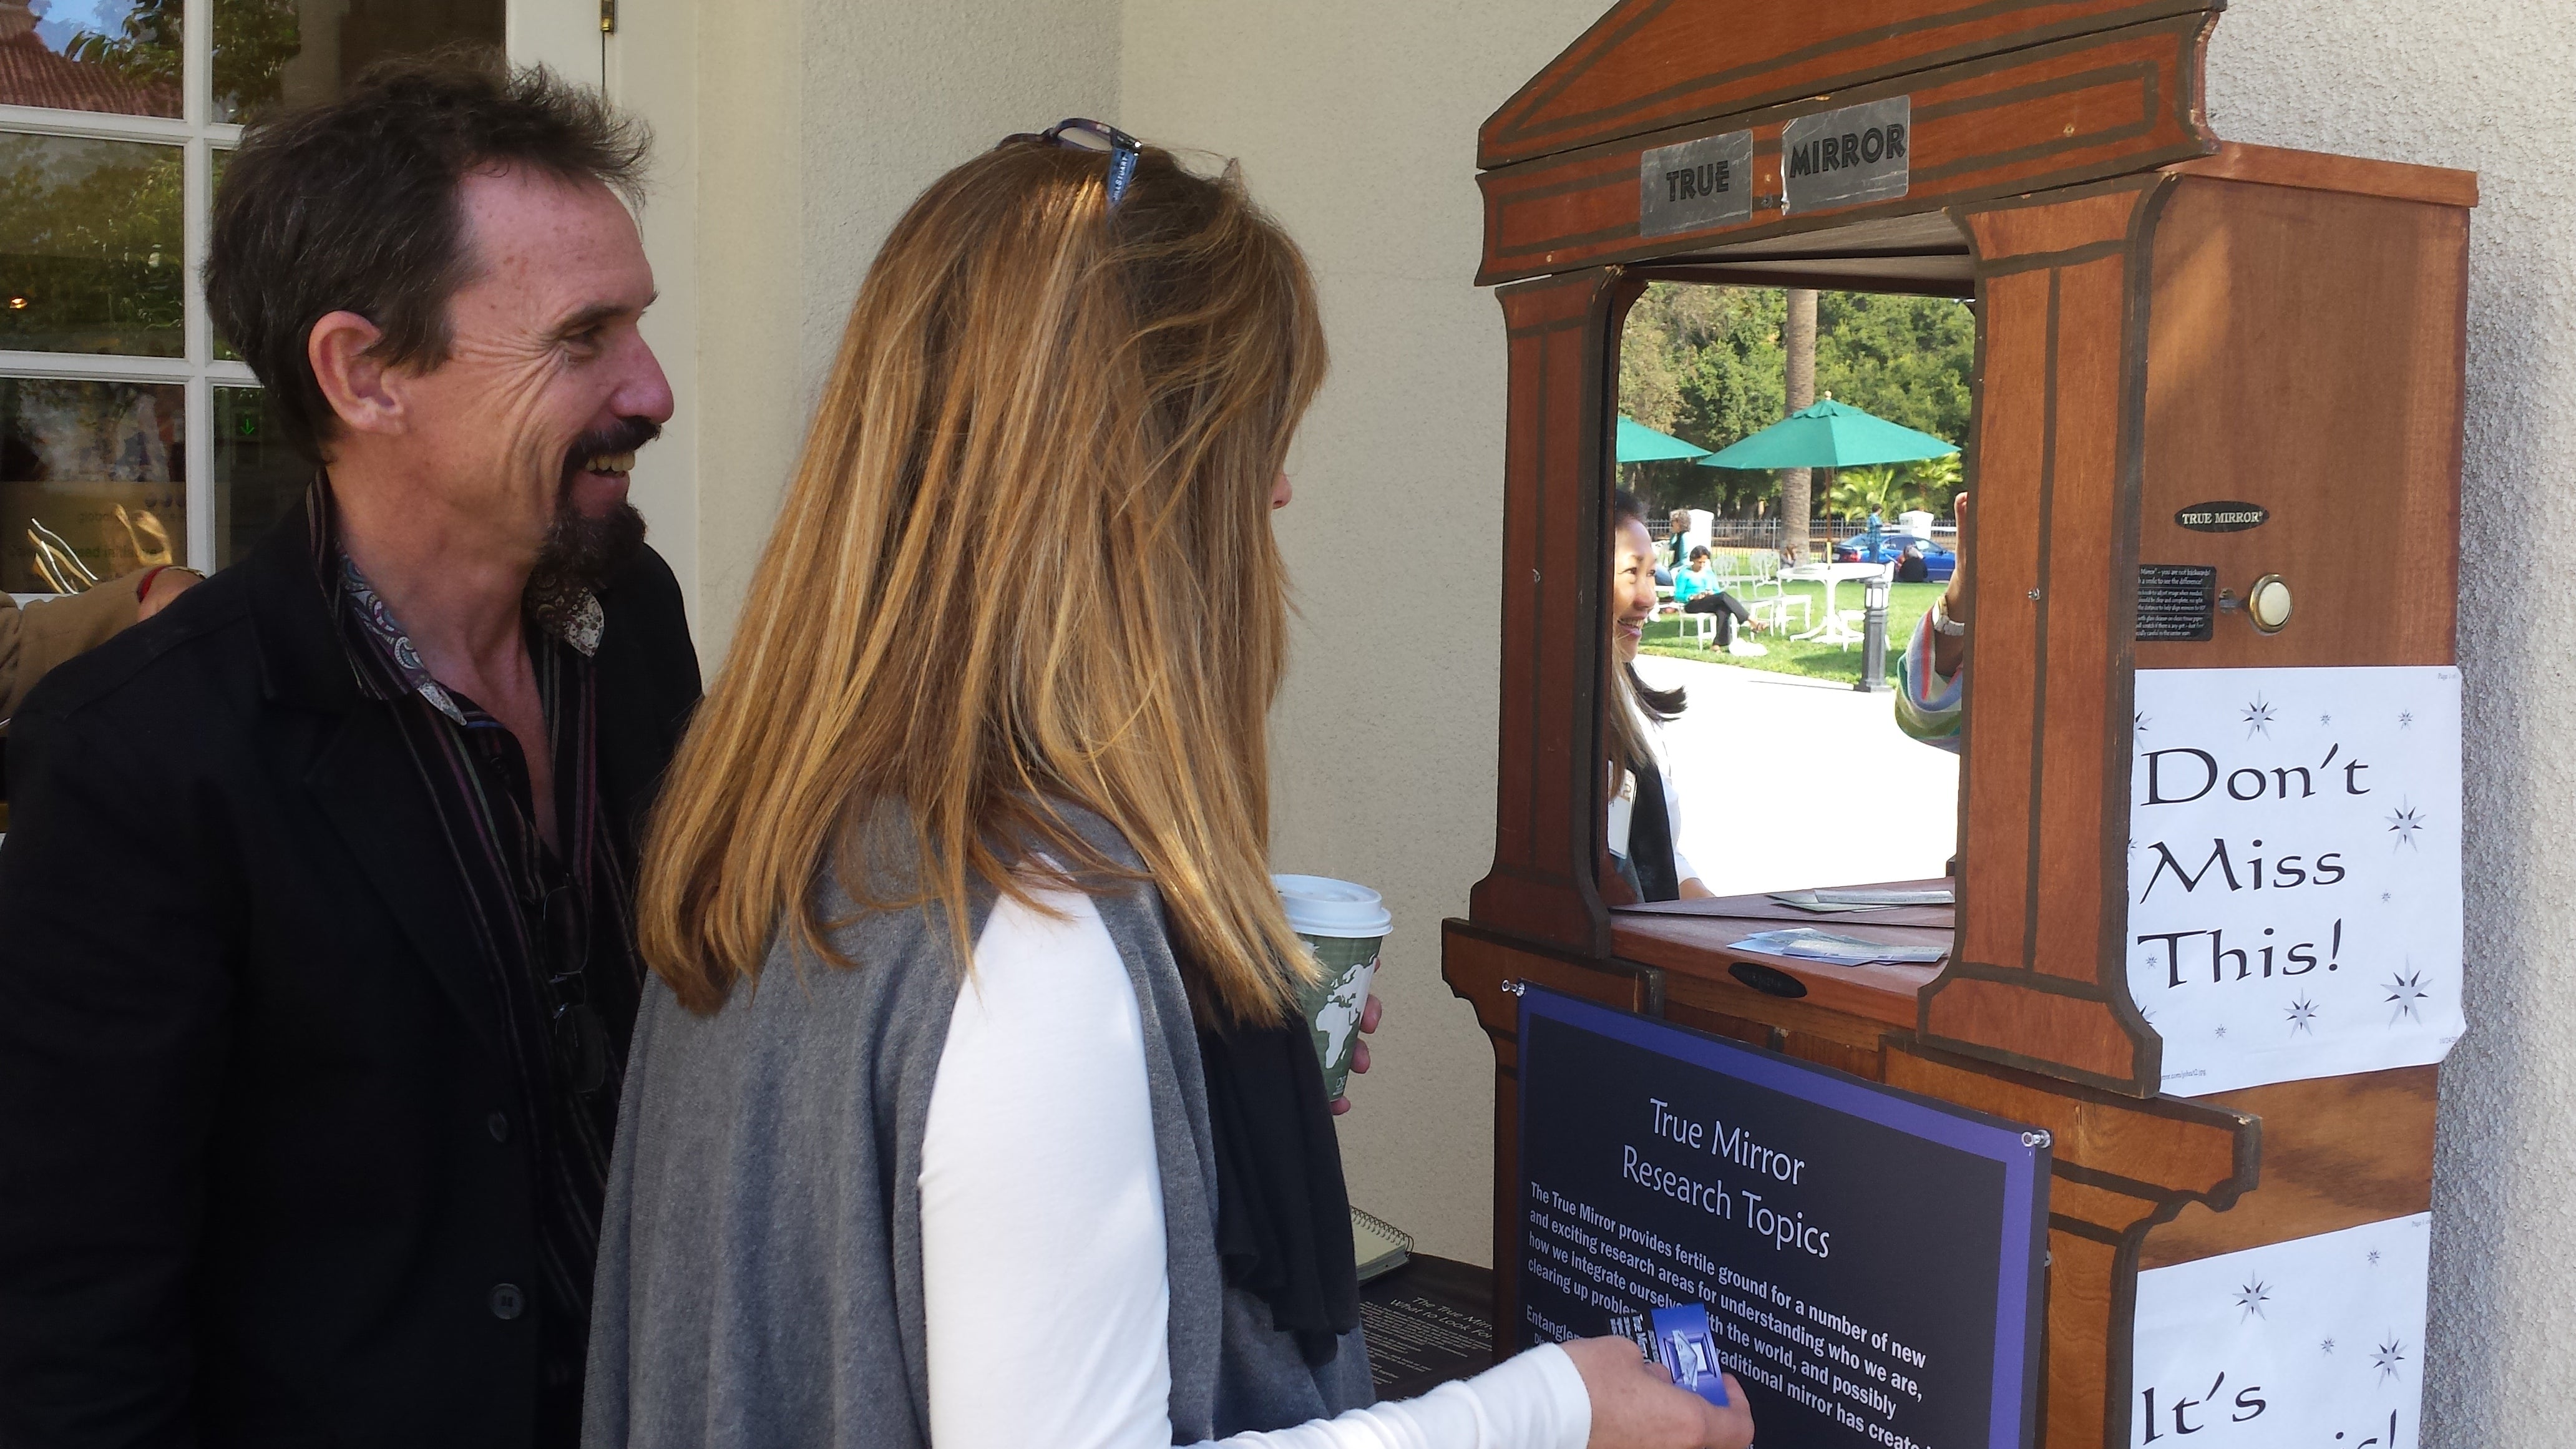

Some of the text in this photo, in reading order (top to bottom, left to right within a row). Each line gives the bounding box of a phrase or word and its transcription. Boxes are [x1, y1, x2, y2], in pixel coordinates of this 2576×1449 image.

[1666, 124, 1906, 202] TRUE MIRROR
[2182, 513, 2212, 524] TRUE
[2140, 743, 2371, 806] Don't
[2140, 838, 2346, 905] Miss
[2138, 917, 2341, 989] This!
[1650, 1098, 1805, 1185] True Mirror
[1623, 1144, 1830, 1258] Research Topics
[1413, 1297, 1435, 1308] The
[1438, 1305, 1463, 1317] True
[1530, 1210, 1923, 1403] and exciting research areas for understanding who we are,
[1531, 1181, 1927, 1368] The True Mirror provides fertile ground for a number of new
[1390, 1299, 1423, 1313] What
[1438, 1317, 1471, 1330] Look
[1527, 1304, 1580, 1342] Entangle
[1530, 1231, 1896, 1420] how we integrate ourselv ith the world, and possibly
[1528, 1258, 1932, 1449] clearing up proble raditional mirror has creat
[2142, 1371, 2266, 1446] It's
